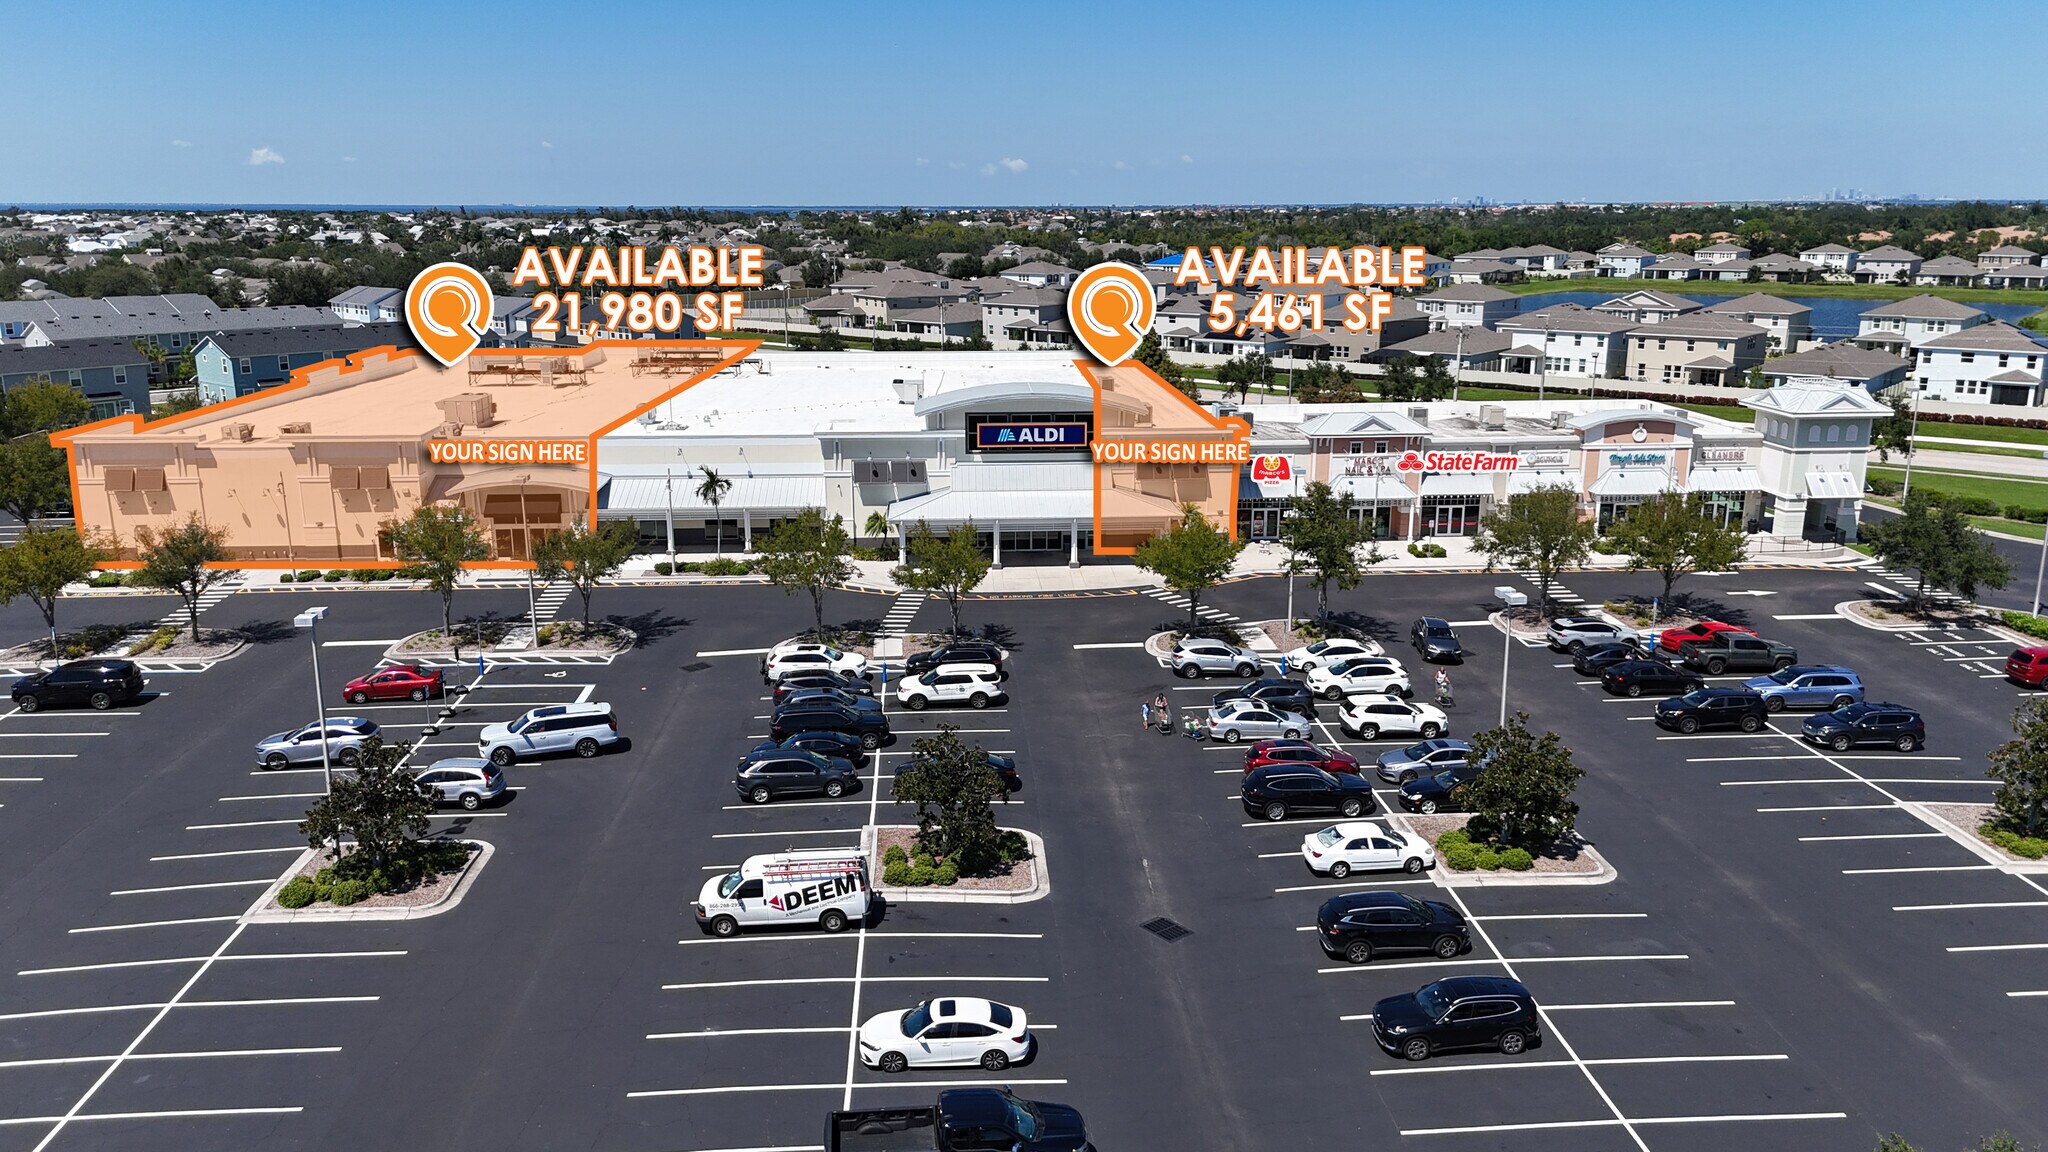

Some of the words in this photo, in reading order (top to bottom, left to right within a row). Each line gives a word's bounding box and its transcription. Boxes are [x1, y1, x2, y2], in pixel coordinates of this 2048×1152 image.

[1018, 427, 1065, 443] ALDI
[1701, 451, 1744, 461] CLEANERS
[784, 873, 857, 911] DEEM
